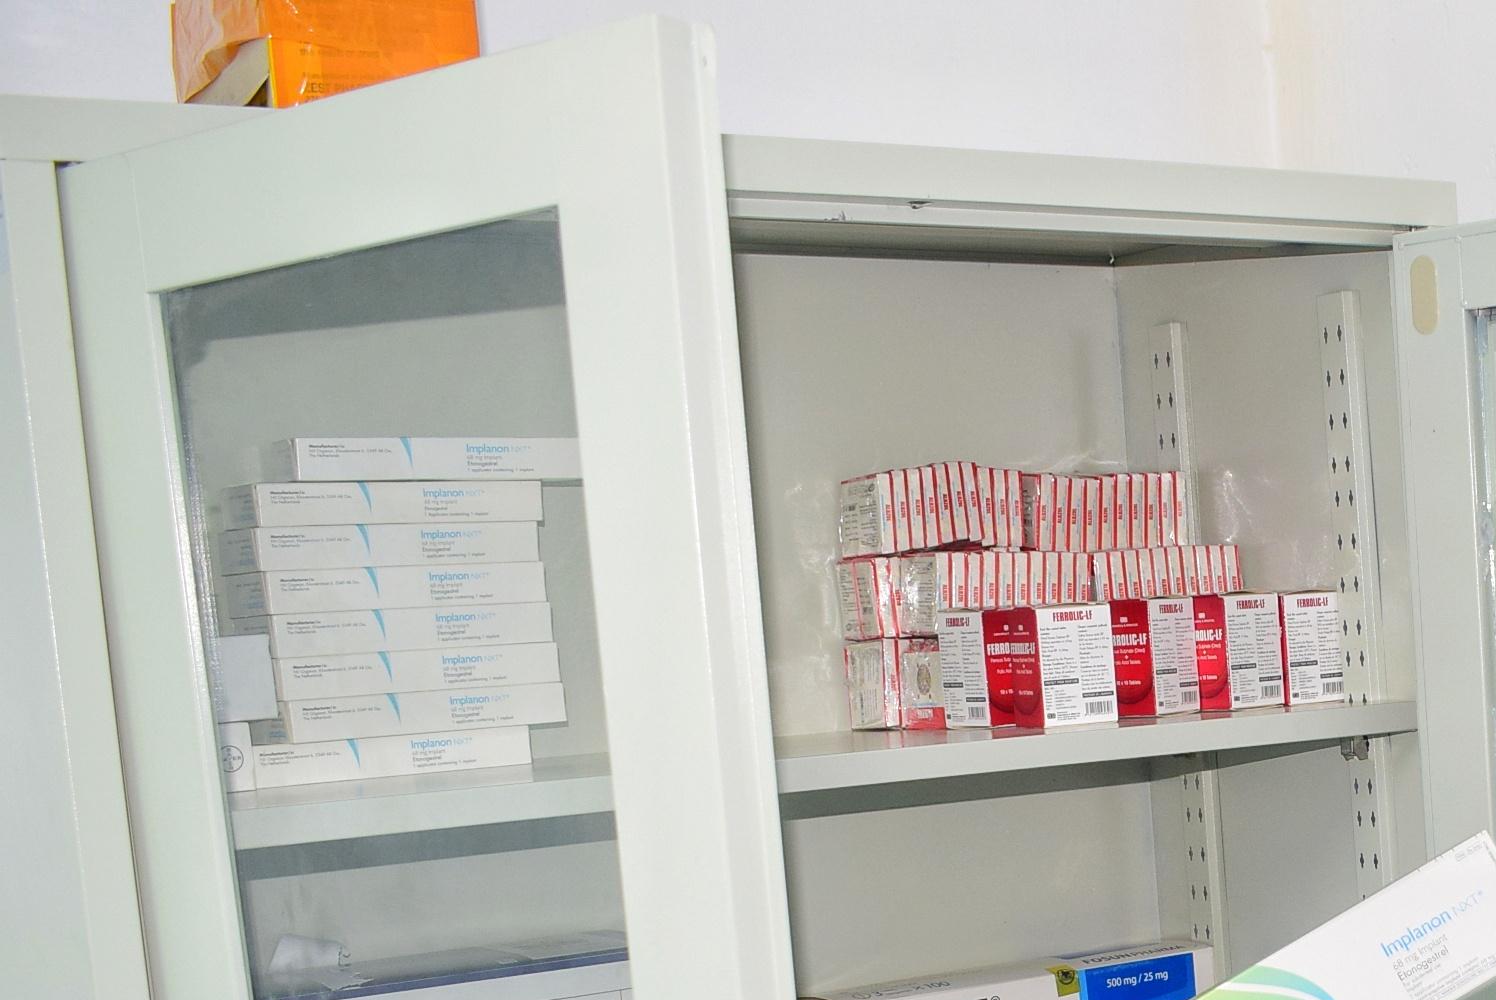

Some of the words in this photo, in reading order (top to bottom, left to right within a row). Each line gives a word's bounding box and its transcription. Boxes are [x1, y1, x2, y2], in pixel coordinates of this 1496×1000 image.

[466, 444, 509, 454] Implanon
[423, 488, 464, 499] Implanon
[421, 529, 462, 540] Implanon
[429, 571, 469, 583] Implanon
[1236, 598, 1265, 611] FERROLIC-LF
[1296, 596, 1328, 608] FERROLIC-LF
[1159, 603, 1184, 614] FERROLIC-LF
[436, 613, 476, 623] Implanon
[1052, 610, 1093, 622] FERROLIC-LF
[442, 655, 483, 665] Implanon
[450, 695, 490, 706] Implanon
[411, 739, 452, 750] Implanon
[1380, 911, 1452, 957] Implanon
[1393, 958, 1404, 970] 68
[1404, 952, 1419, 963] mg
[1417, 933, 1448, 955] Implant
[1082, 953, 1130, 965] FOSUN
[1397, 944, 1449, 982] Etonogestrel
[1106, 976, 1122, 988] 500
[1123, 976, 1137, 986] mg
[1138, 973, 1142, 983] /
[1143, 972, 1154, 982] 25
[1154, 970, 1169, 981] mg
